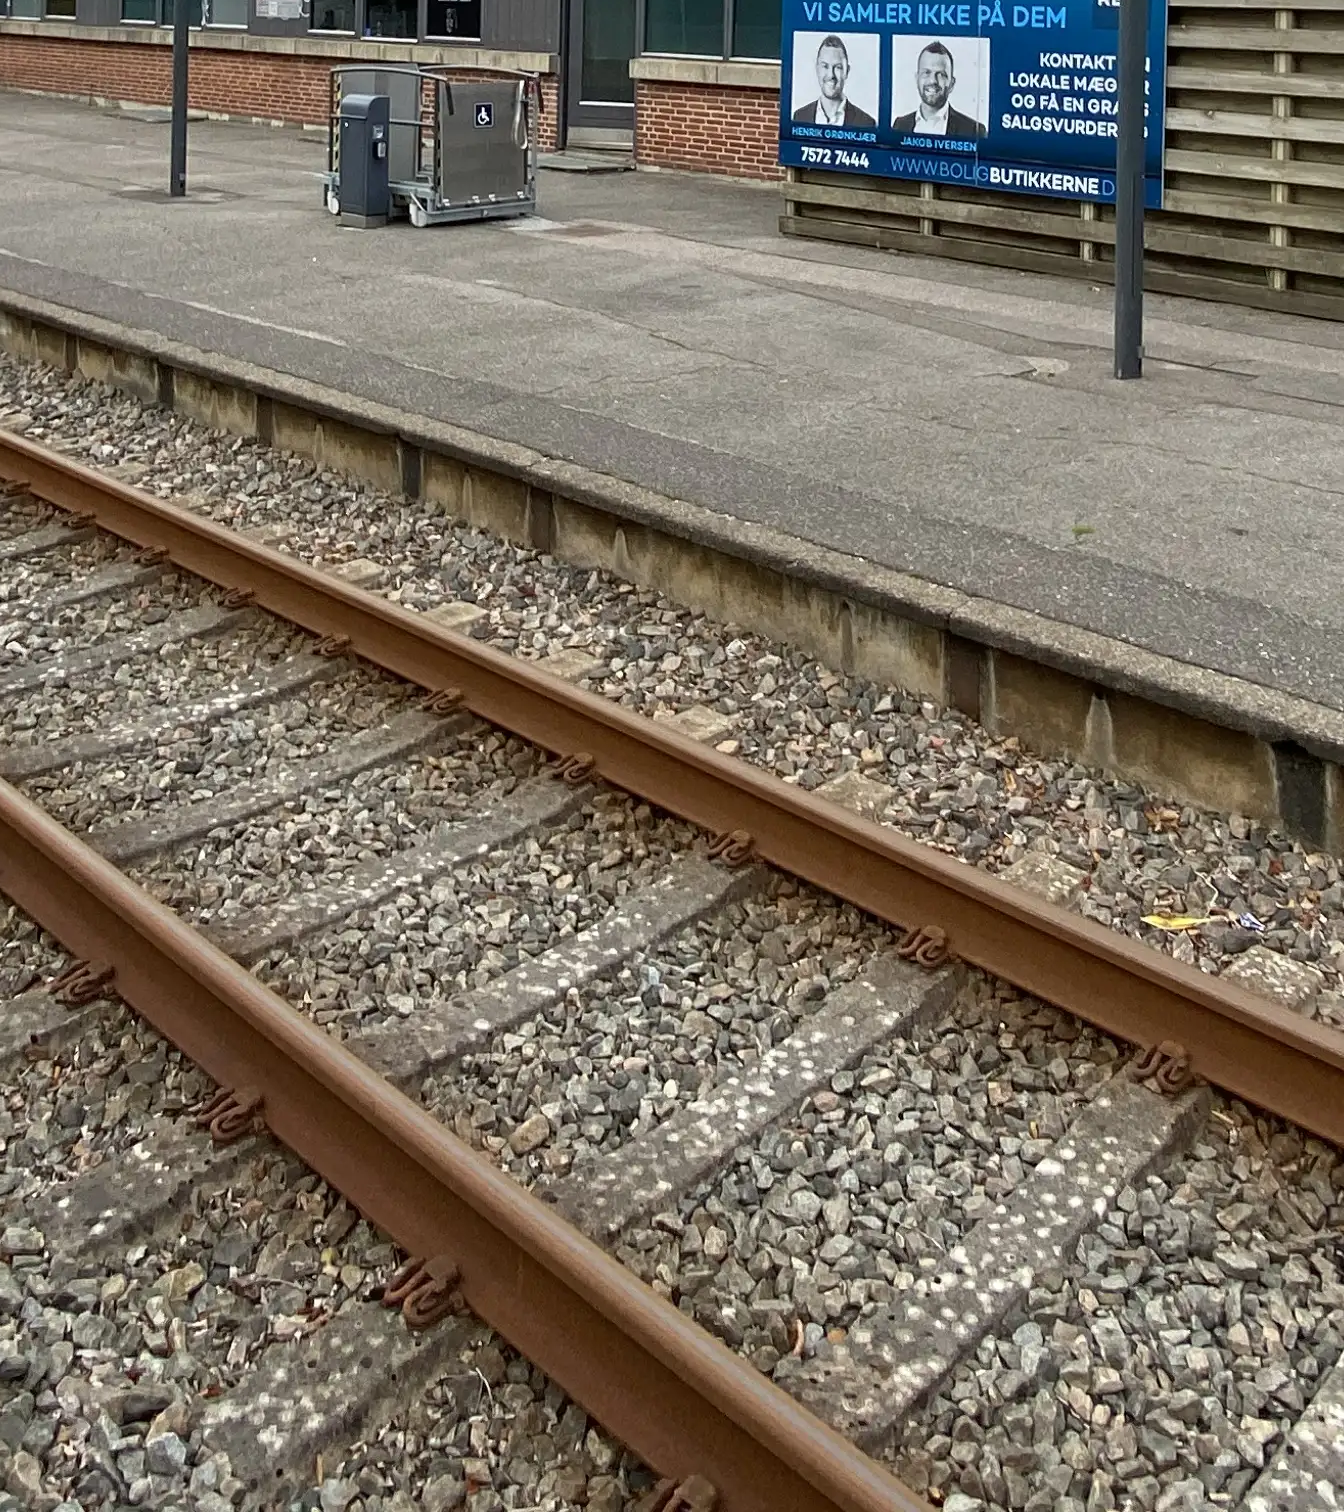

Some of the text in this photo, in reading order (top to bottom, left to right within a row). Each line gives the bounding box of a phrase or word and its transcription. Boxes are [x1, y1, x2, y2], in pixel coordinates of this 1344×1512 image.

[803, 0, 1067, 29] VI SAMLER IKKE PÅ DEM
[1040, 52, 1116, 70] KONTAKT
[1009, 72, 1149, 95] LOKALE MÆG
[1011, 93, 1035, 109] OG
[1040, 92, 1059, 112] FÅ
[1063, 96, 1084, 113] EN
[792, 126, 876, 143] HENRIK GRØNKJÆR
[1001, 113, 1148, 138] SALGSVURDER
[900, 136, 977, 152] JAKOB IVERSEN
[801, 146, 869, 168] 7572 7444
[890, 156, 1115, 196] WWW.BOLIGBUTIKKERNE.D
